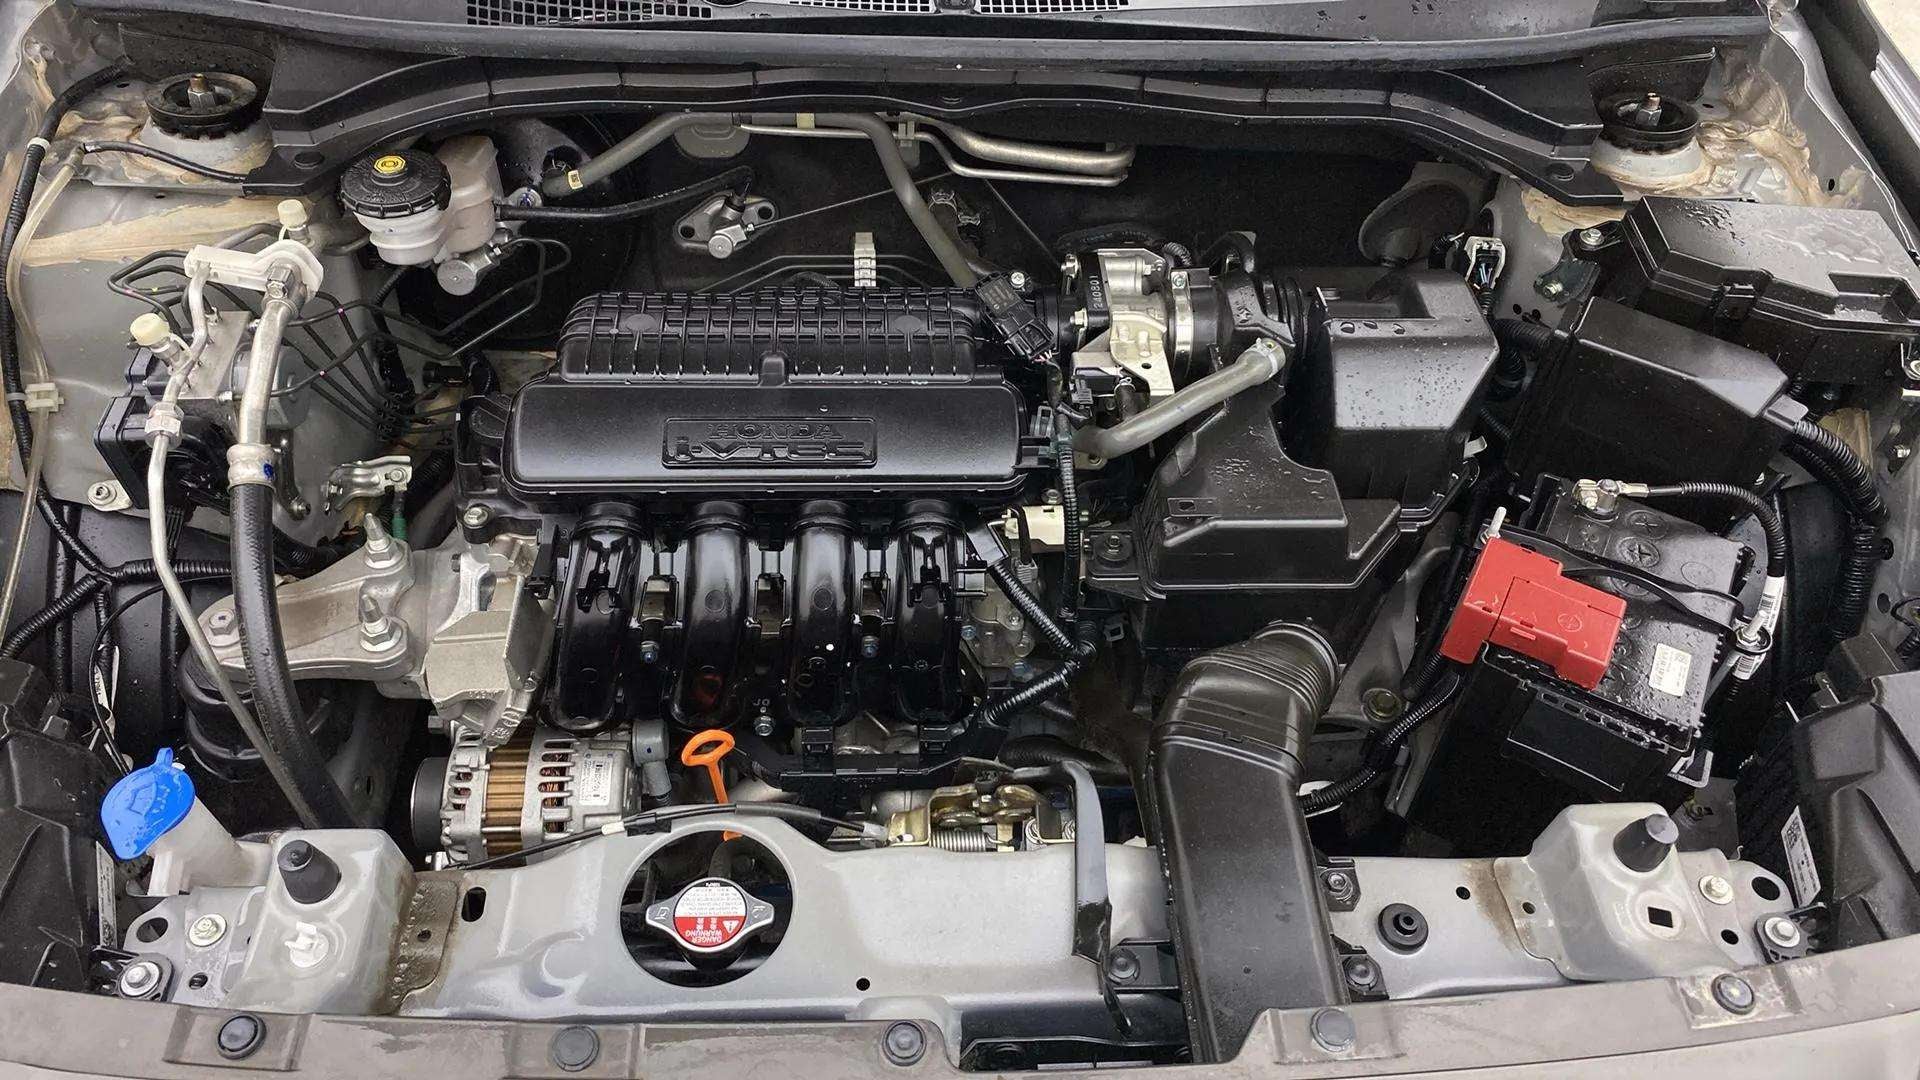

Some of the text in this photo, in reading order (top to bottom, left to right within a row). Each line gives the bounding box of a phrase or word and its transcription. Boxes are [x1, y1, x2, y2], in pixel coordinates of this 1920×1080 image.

[1089, 275, 1103, 309] 240801
[709, 424, 843, 440] HONDA
[675, 436, 865, 461] i-VTEC
